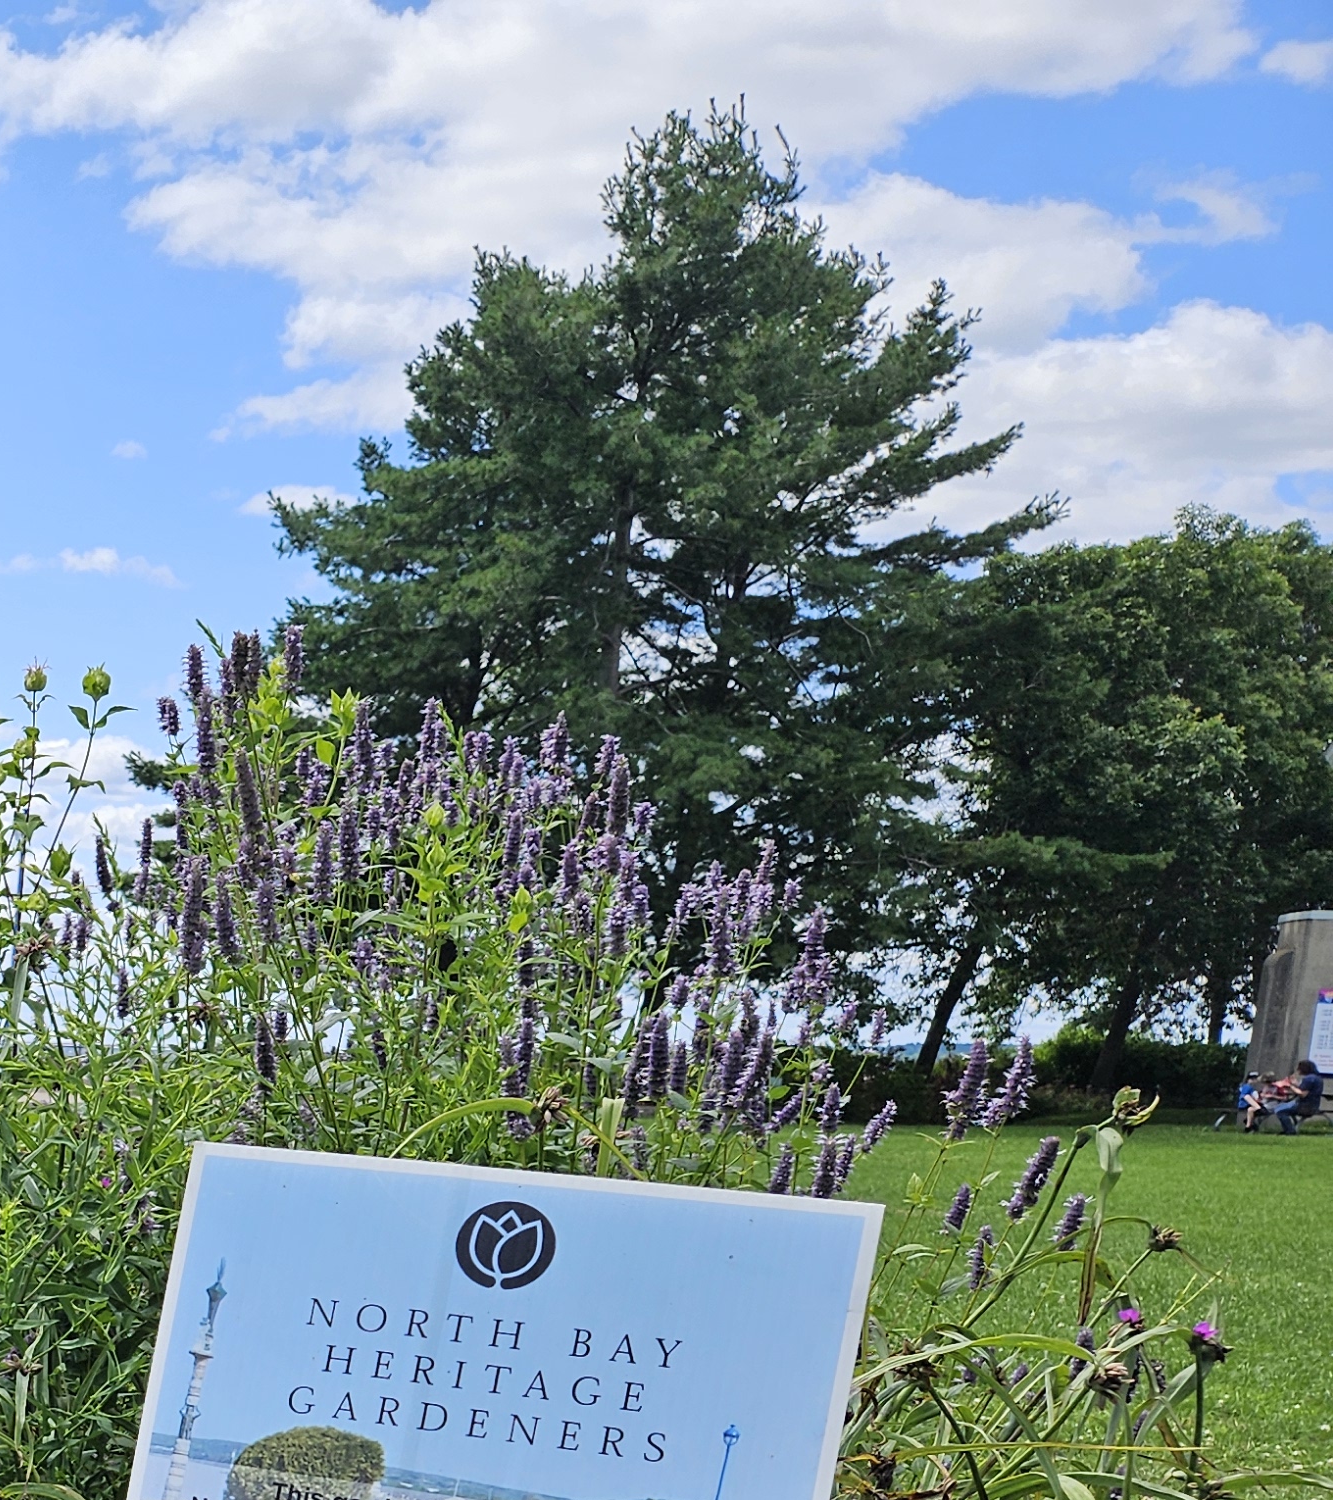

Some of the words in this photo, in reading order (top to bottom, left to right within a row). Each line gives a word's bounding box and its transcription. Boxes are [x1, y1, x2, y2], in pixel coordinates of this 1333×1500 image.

[306, 1298, 525, 1350] NORTH
[570, 1328, 682, 1368] BAY
[322, 1344, 646, 1413] HERITAGE
[288, 1386, 667, 1463] GARDENERS
